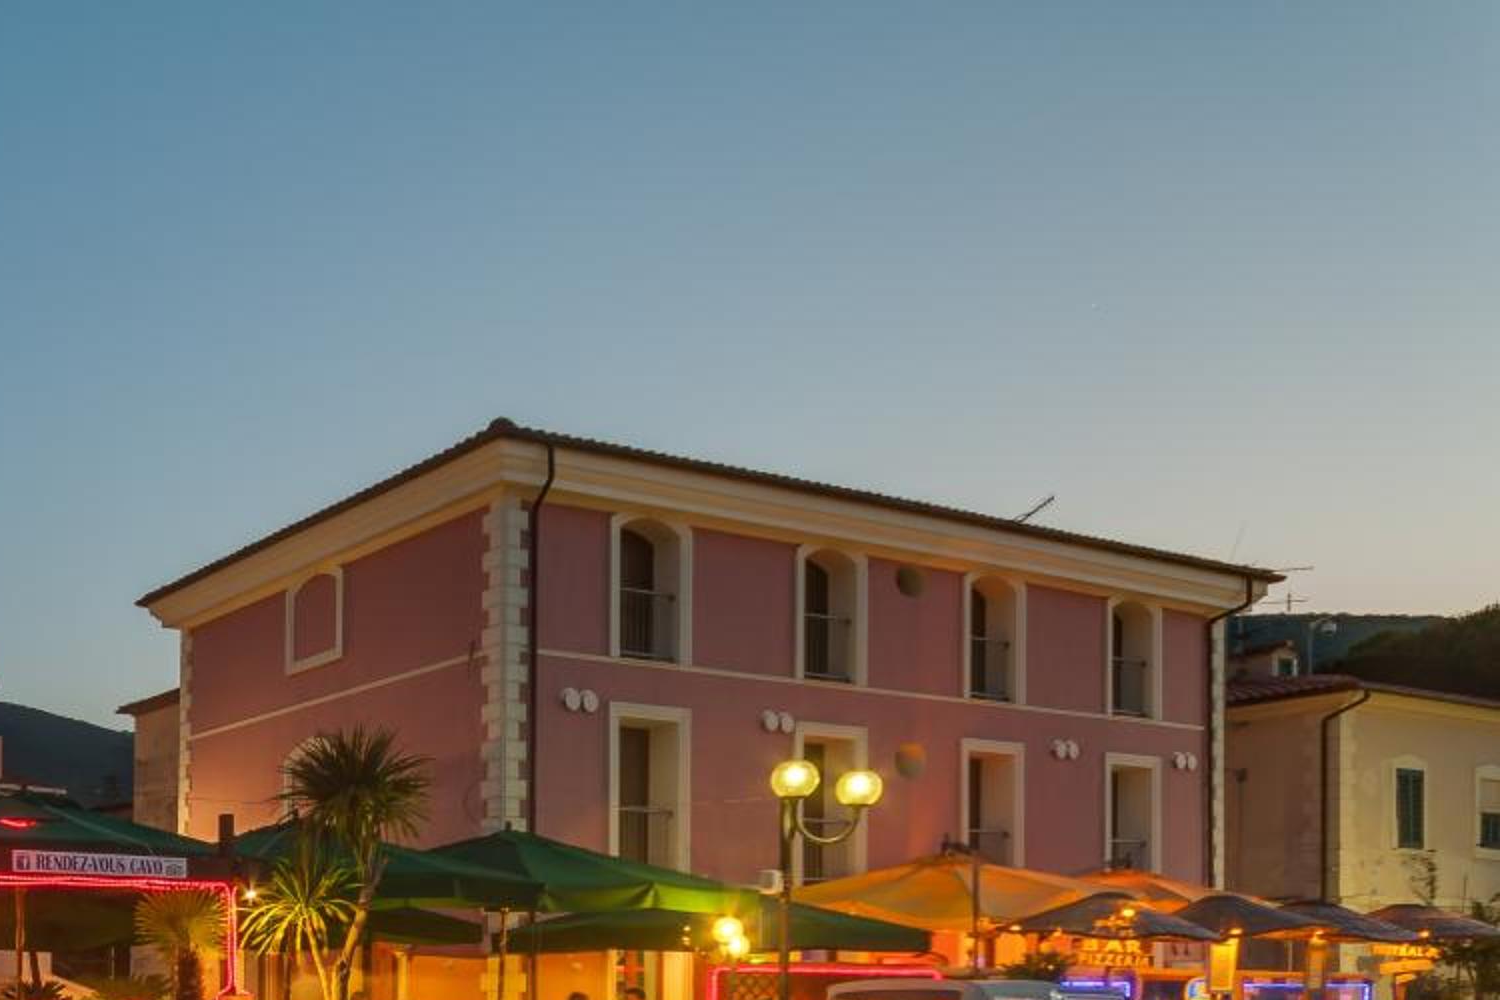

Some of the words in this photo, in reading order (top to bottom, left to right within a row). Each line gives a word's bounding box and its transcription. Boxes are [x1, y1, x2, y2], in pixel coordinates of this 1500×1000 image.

[36, 853, 126, 873] RENDEZ-VOUS
[129, 858, 163, 874] CAVO
[1082, 938, 1141, 953] BAR
